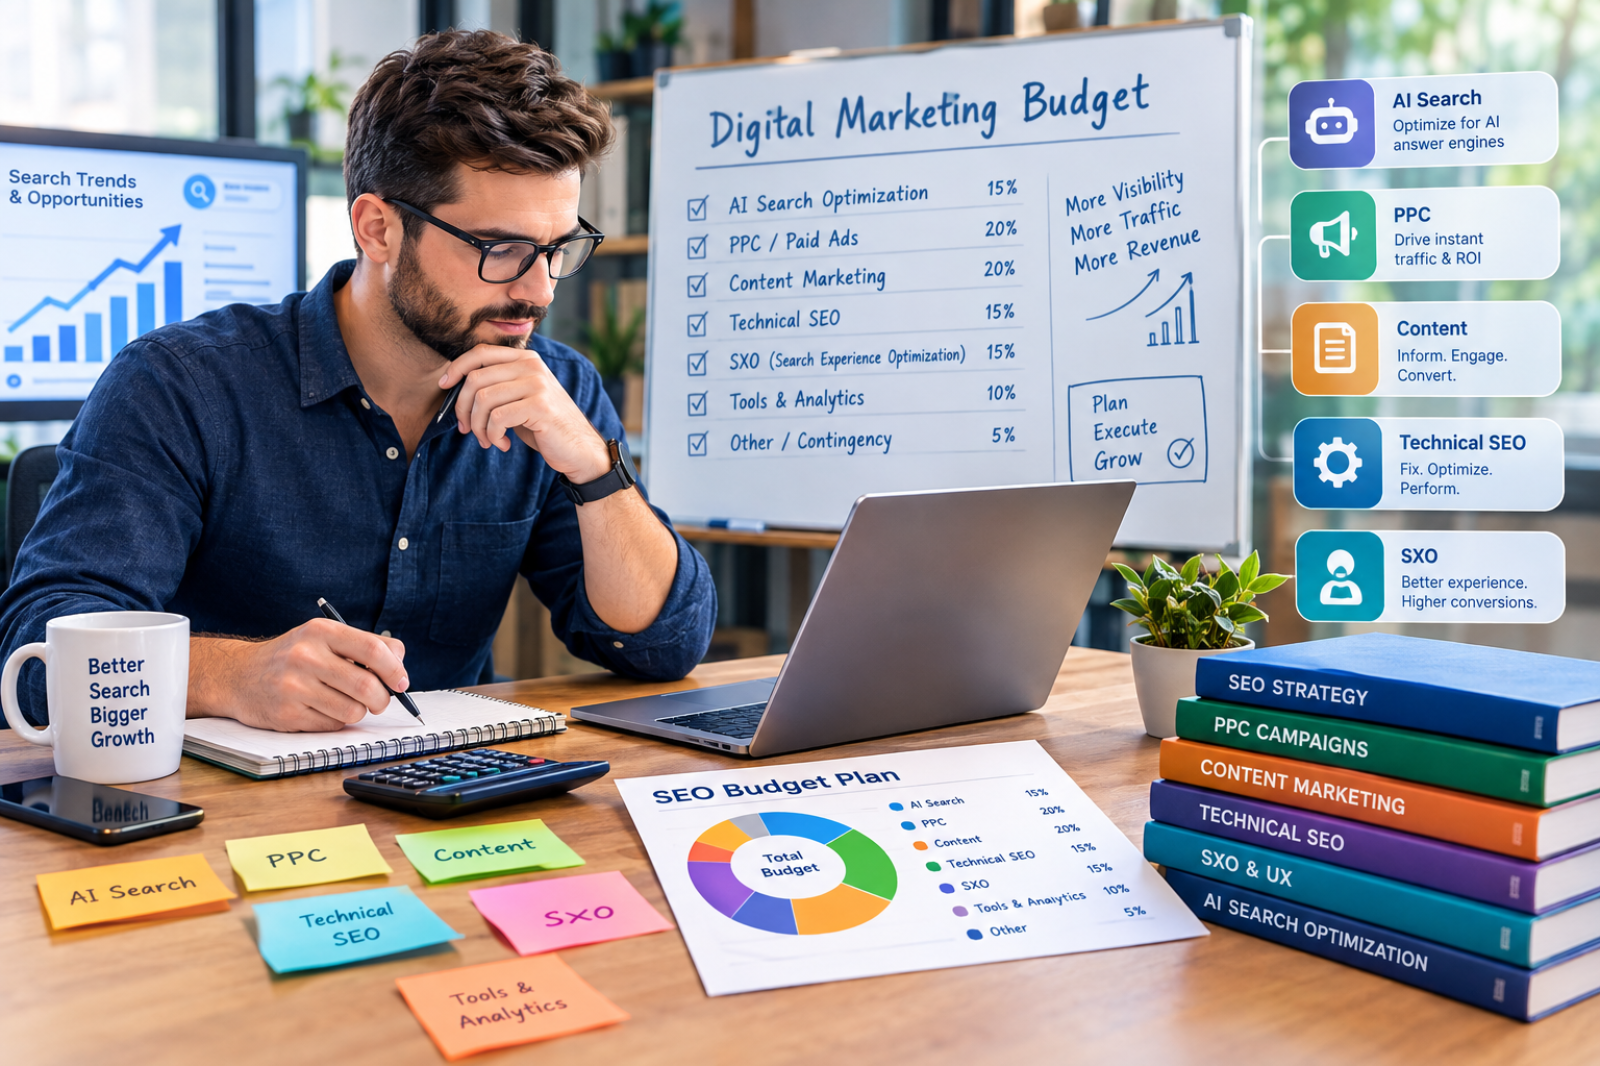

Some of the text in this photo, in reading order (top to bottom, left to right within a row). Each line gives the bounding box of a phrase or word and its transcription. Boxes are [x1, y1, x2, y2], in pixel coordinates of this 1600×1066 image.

[709, 73, 1150, 157] Digital Marketing Budget
[9, 169, 137, 188] Search Trends
[9, 189, 143, 208] & Opportunities
[728, 179, 1018, 214] AI Search Optimization 15%
[1066, 170, 1184, 216] More Visibility
[730, 220, 1018, 254] PPC / Paid Ads 20%
[1070, 201, 1182, 245] More Traffic
[1074, 228, 1201, 276] More Revenue
[729, 260, 1016, 292] Content Marketing 20%
[729, 303, 1015, 331] Technical SEO 15%
[729, 343, 1015, 371] SXO (Search Experience Optimization) 15%
[729, 384, 1016, 414] Tools & Analytics 10%
[1092, 394, 1128, 413] Plan
[730, 427, 1016, 455] Other / Contingency 5%
[1094, 419, 1158, 441] Execute
[1094, 450, 1143, 470] Grow
[88, 658, 145, 675] Better
[89, 680, 150, 700] Search
[1228, 674, 1369, 707] SEO STRATEGY
[90, 706, 148, 727] Bigger
[91, 728, 154, 748] Growth
[1214, 716, 1369, 758] PPC CAMPAIGNS
[652, 770, 901, 804] SEO Budget Plan
[910, 788, 1049, 809] AI Search 15%
[1200, 758, 1405, 815] CONTENT MARKETING
[921, 806, 1065, 829] PPC 20%
[1199, 803, 1344, 852] TECHNICAL SEO
[934, 823, 1080, 848] Content 20%
[267, 848, 327, 868] PPC
[434, 838, 537, 862] Content
[762, 851, 804, 864] Total
[946, 842, 1096, 869] Technical SEO 15%
[761, 863, 820, 878] Budget
[961, 862, 1113, 891] SXO 15%
[1201, 849, 1292, 887] SXO & UX
[69, 876, 197, 906] AI Search
[974, 884, 1130, 915] Tools & Analytics 10%
[299, 901, 395, 929] Technical
[544, 906, 615, 927] SXO
[990, 906, 1146, 937] Other 5%
[333, 927, 381, 947] SEO
[1203, 892, 1428, 972] AI SEARCH OPTIMIZATION
[449, 981, 535, 1007] Tools &
[459, 999, 567, 1030] Analytics
